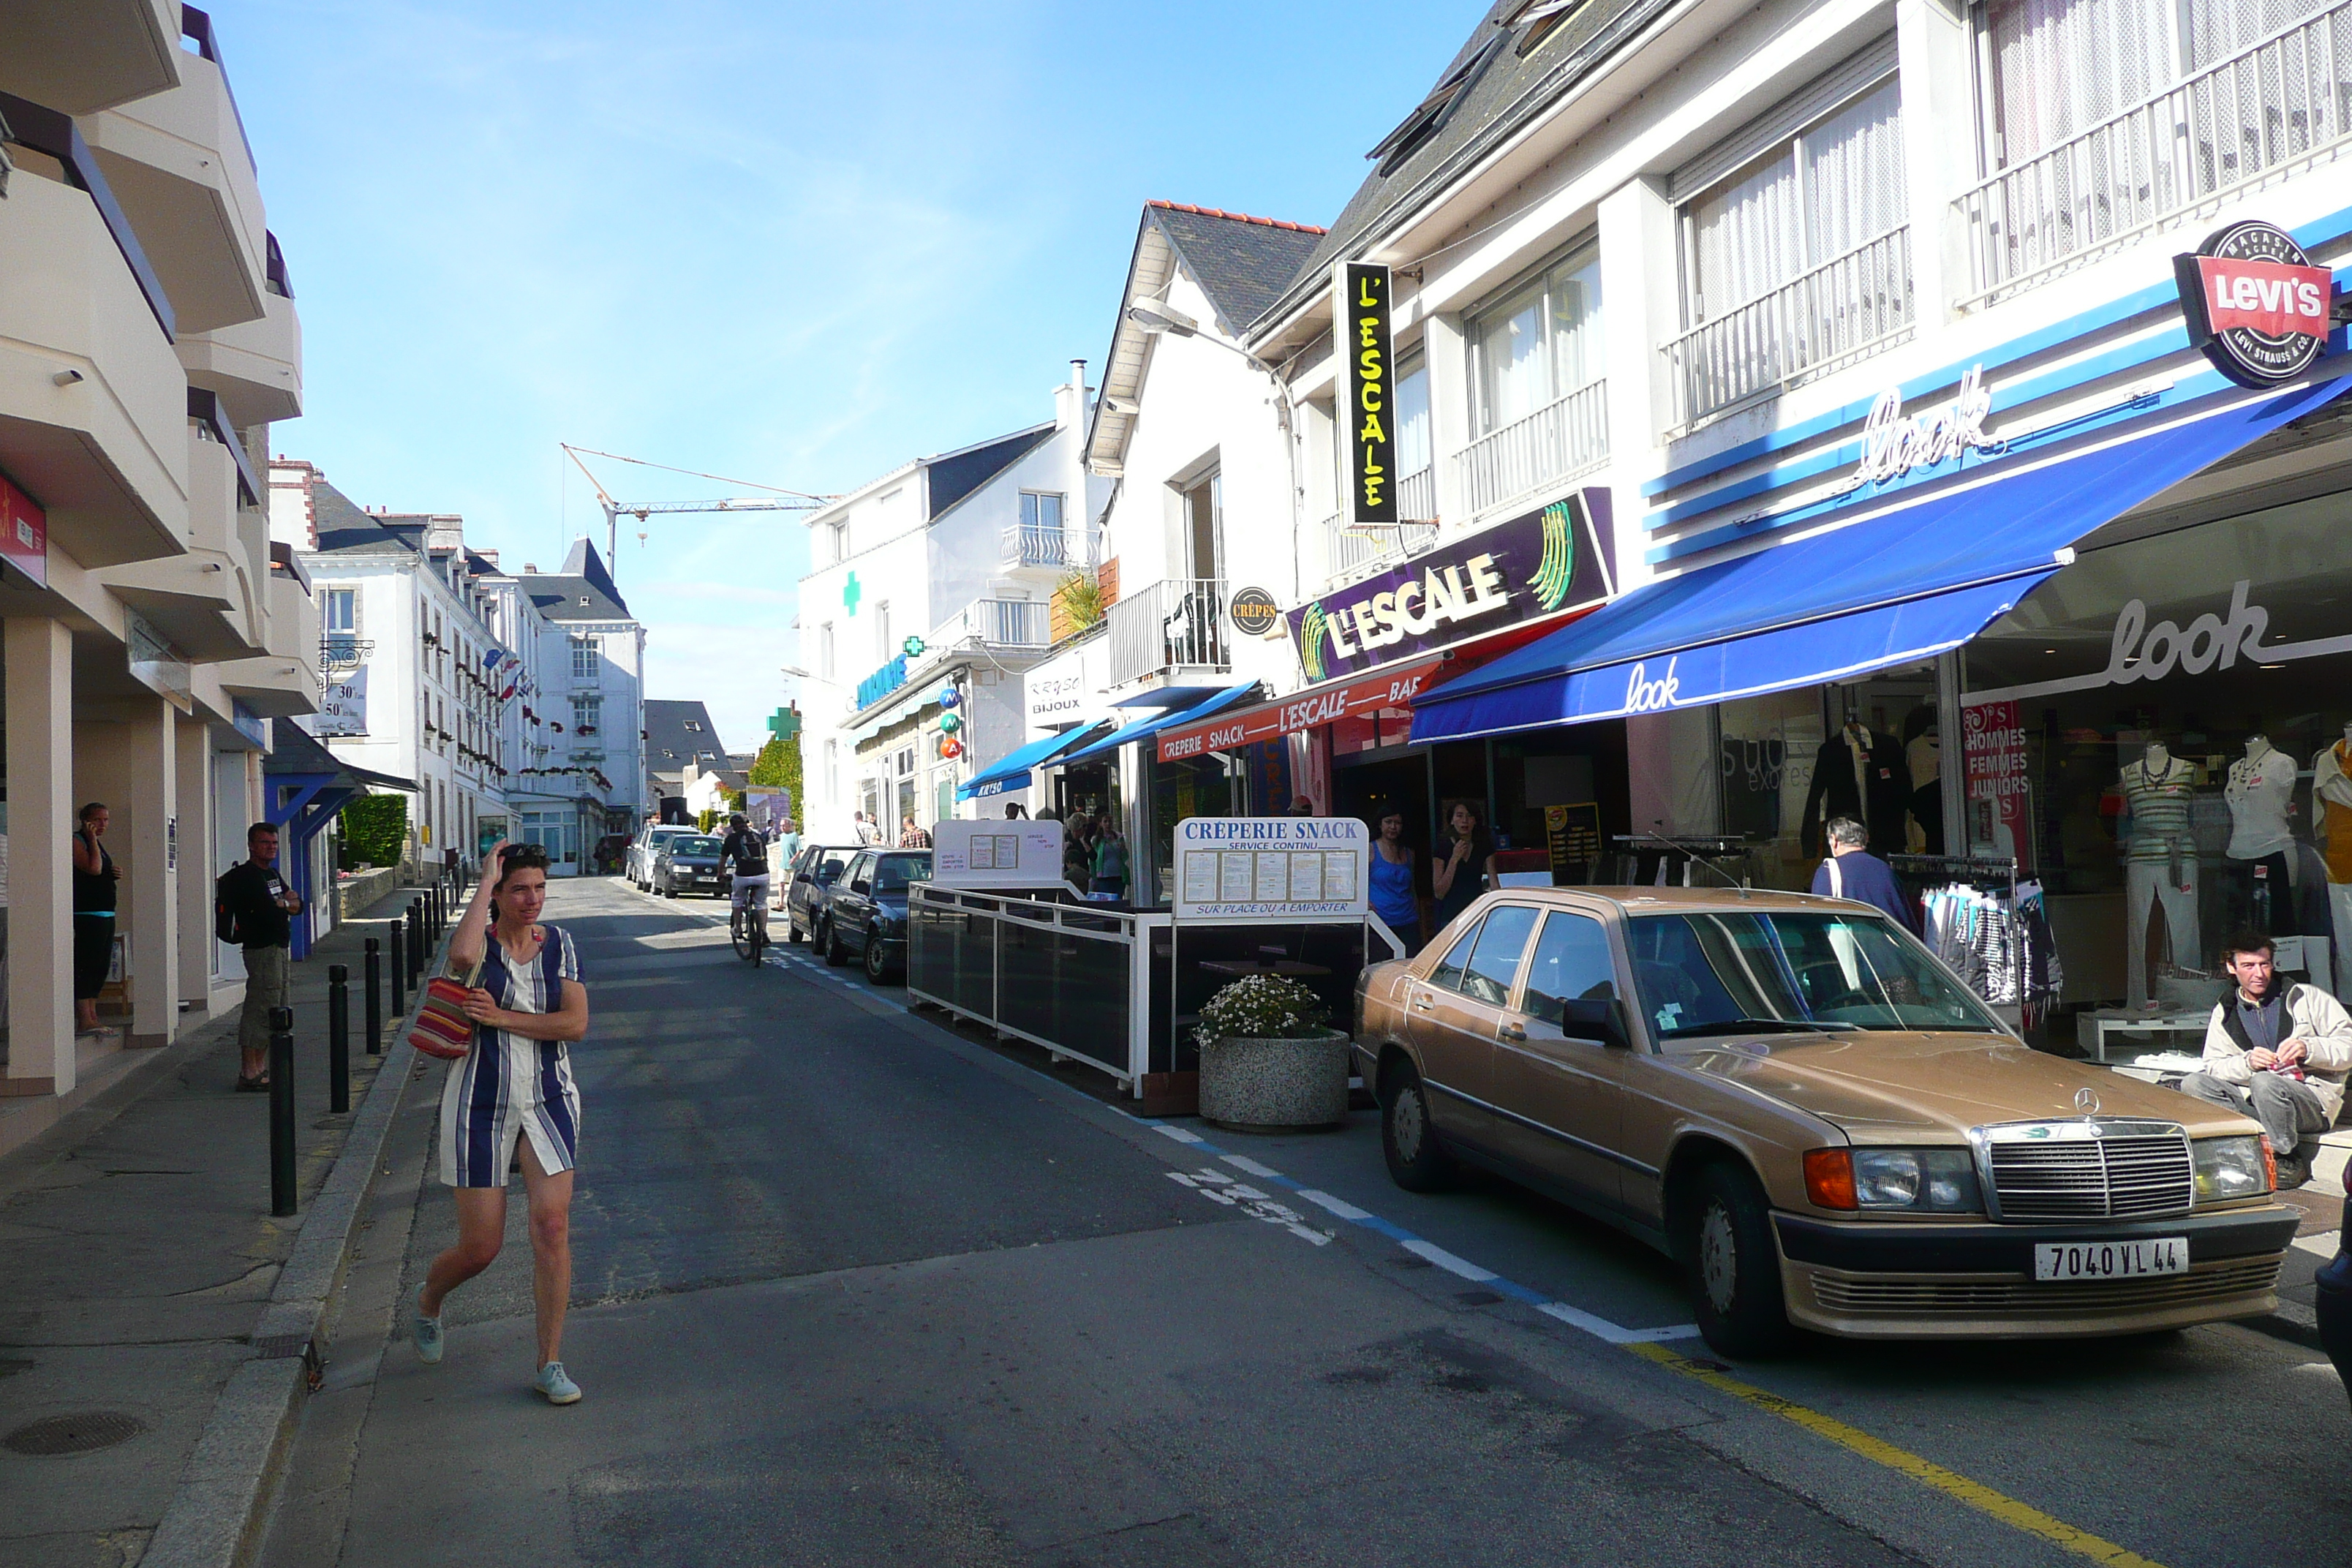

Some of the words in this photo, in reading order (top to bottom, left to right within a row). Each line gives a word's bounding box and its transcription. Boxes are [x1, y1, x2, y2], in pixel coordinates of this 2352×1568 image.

[2226, 232, 2301, 263] MAGASIN
[2234, 330, 2253, 353] LEVI
[2254, 347, 2291, 364] STRAUSS
[2291, 346, 2300, 358] &
[1359, 276, 1386, 506] L'ESCALE
[1232, 600, 1276, 618] CRÊPES
[1325, 552, 1509, 660] L'ESCALE
[2110, 578, 2269, 685] look
[1624, 655, 1680, 714] look
[1033, 699, 1080, 714] BIJOUX
[1164, 735, 1202, 758] CREPERIE
[1209, 724, 1245, 749] SNACK
[1279, 690, 1349, 733] L'ESCALE
[1967, 727, 2027, 751] HOMMES
[1970, 753, 2028, 774] FEMMES
[977, 781, 1003, 798] KRYSO
[1970, 775, 2029, 797] JUNIORS
[1295, 821, 1357, 840] SNACK
[1229, 842, 1270, 850] SERVICE
[1273, 842, 1318, 850] CONTINU
[1196, 904, 1221, 914] SUR
[1223, 904, 1257, 913] PLACE
[1259, 903, 1277, 913] OU
[1289, 902, 1349, 912] EMPORTER
[2051, 1246, 2114, 1277] 7040
[2121, 1244, 2147, 1275] VL
[2154, 1242, 2176, 1272] 44
